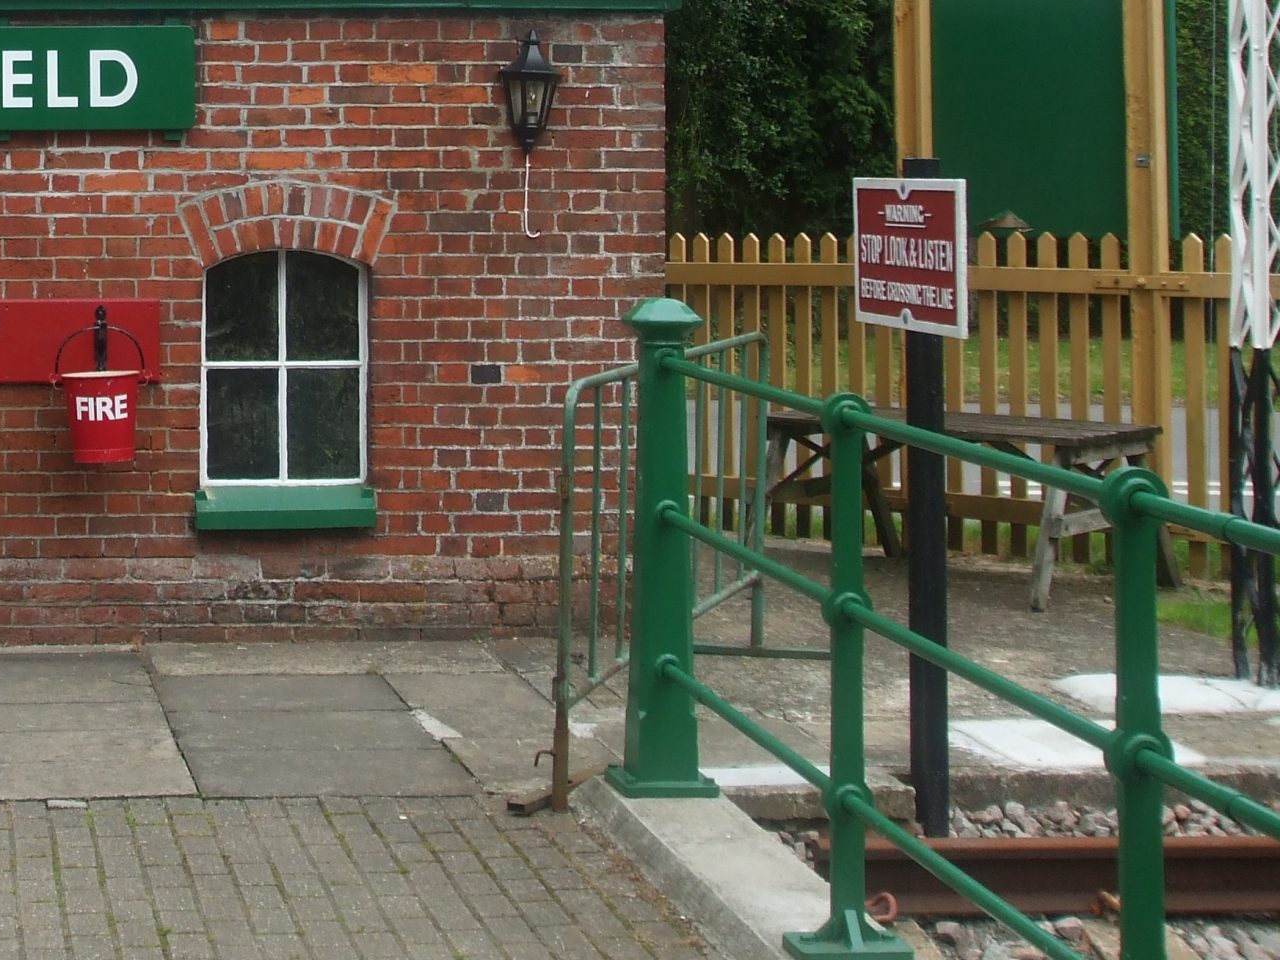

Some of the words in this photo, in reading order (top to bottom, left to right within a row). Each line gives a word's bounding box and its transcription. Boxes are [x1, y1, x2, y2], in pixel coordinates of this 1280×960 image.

[885, 203, 925, 224] WARNING
[861, 234, 882, 264] STOP
[884, 235, 909, 267] LOOK
[909, 239, 919, 268] &
[919, 238, 954, 272] LISTEN
[861, 277, 887, 301] BEFORE
[887, 281, 921, 306] CROSSING
[921, 285, 937, 307] THE
[936, 287, 954, 310] LINE
[75, 394, 128, 422] FIRE
